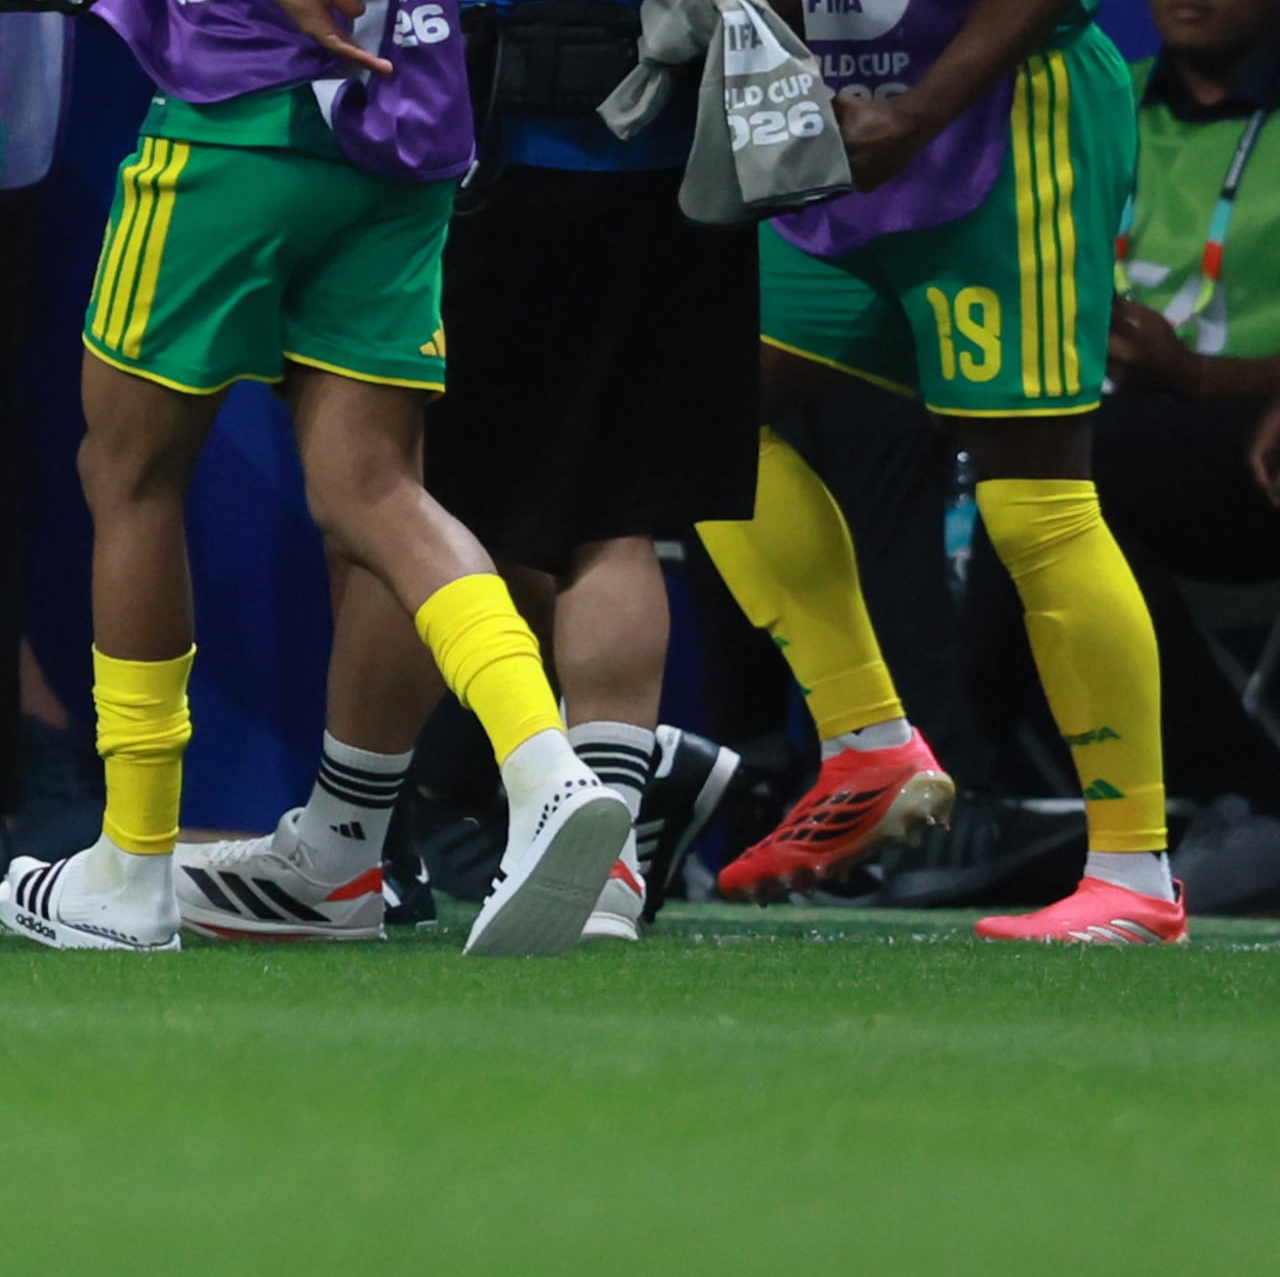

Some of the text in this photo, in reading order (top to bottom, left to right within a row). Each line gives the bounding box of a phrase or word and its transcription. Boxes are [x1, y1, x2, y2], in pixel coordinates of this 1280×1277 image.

[726, 23, 765, 52] IFA
[859, 52, 911, 77] CUP
[767, 73, 814, 105] CUP
[926, 285, 1002, 383] 19
[16, 913, 57, 941] adidas
